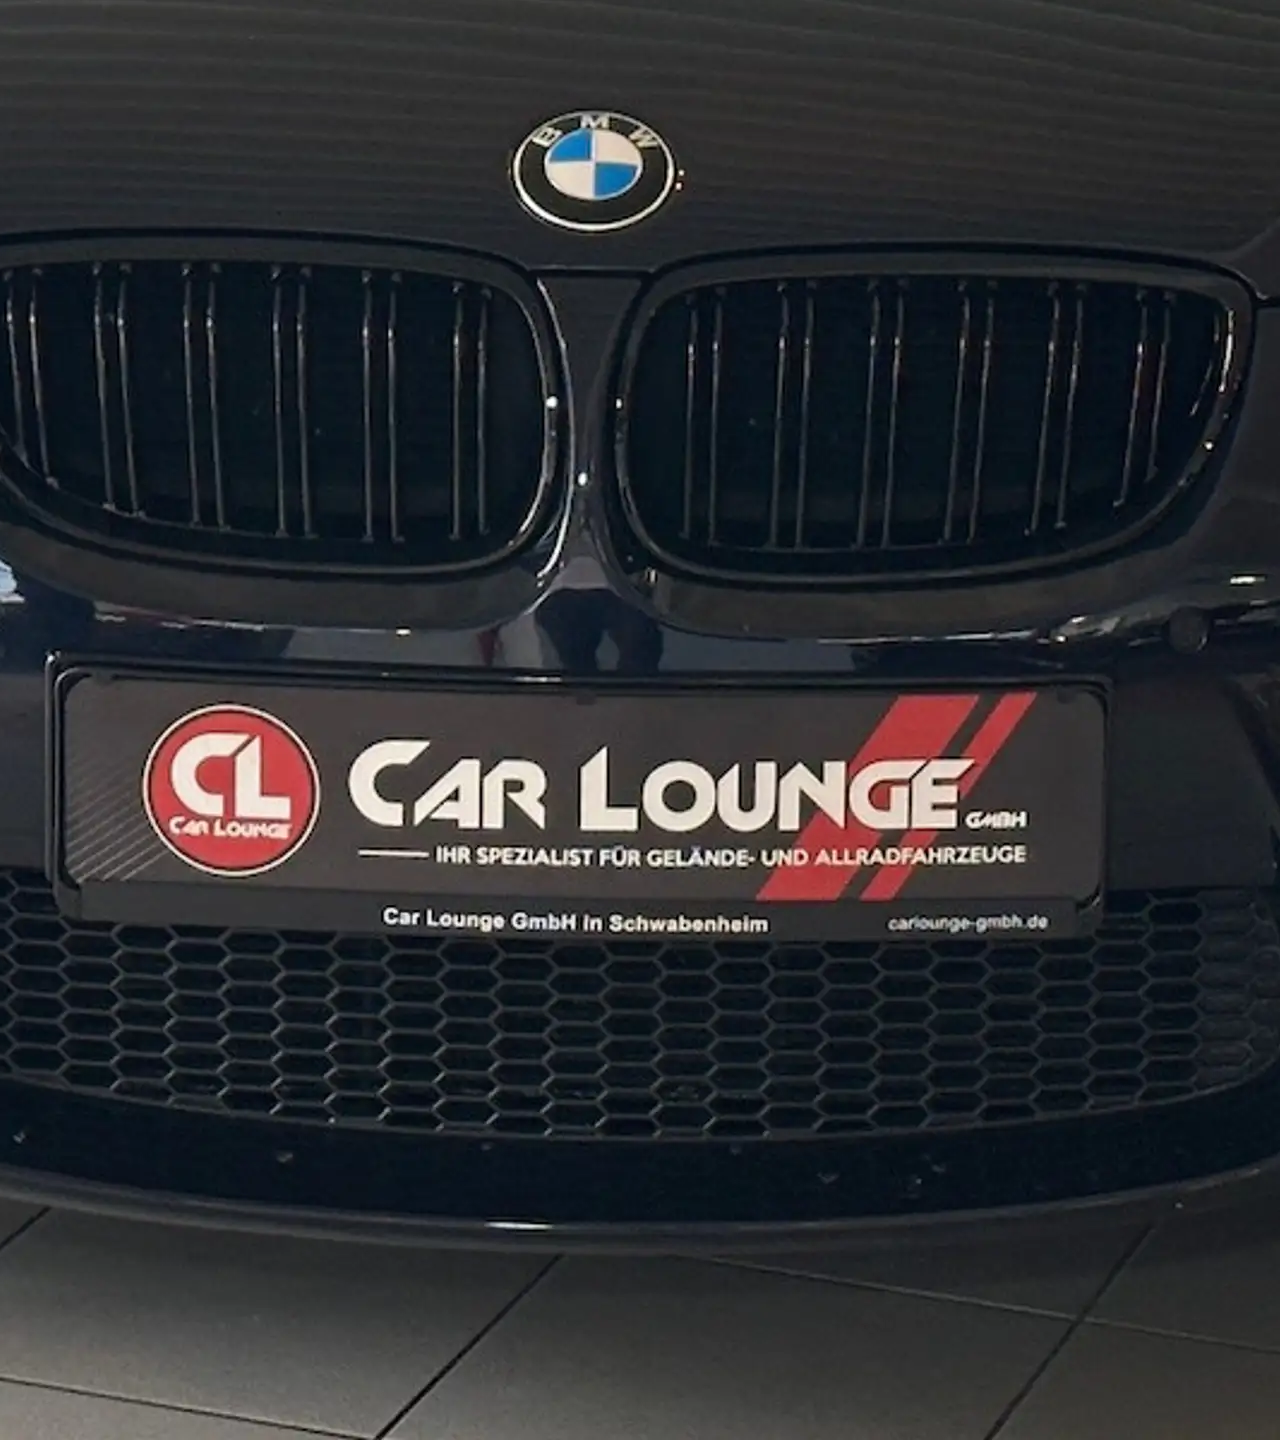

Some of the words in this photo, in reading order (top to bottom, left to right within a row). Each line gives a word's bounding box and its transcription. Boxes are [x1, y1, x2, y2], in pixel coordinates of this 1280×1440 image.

[532, 112, 659, 148] BMW
[171, 731, 291, 819] CL
[348, 739, 546, 830] CAR
[579, 745, 975, 833] LOUNGE
[436, 845, 471, 864] IHR
[476, 846, 594, 868] SPEZIALIST
[599, 845, 642, 868] FÜR
[646, 846, 756, 868] GELÄNDE-
[760, 848, 810, 868] UND
[814, 844, 1027, 867] ALLRADFAHRZEUGE
[383, 907, 421, 927] Car
[426, 908, 505, 934] Lounge
[510, 911, 577, 932] GmbH
[583, 914, 603, 932] in
[608, 914, 769, 934] Schwabenheim
[887, 914, 1050, 936] carlounge-gmbh.de
